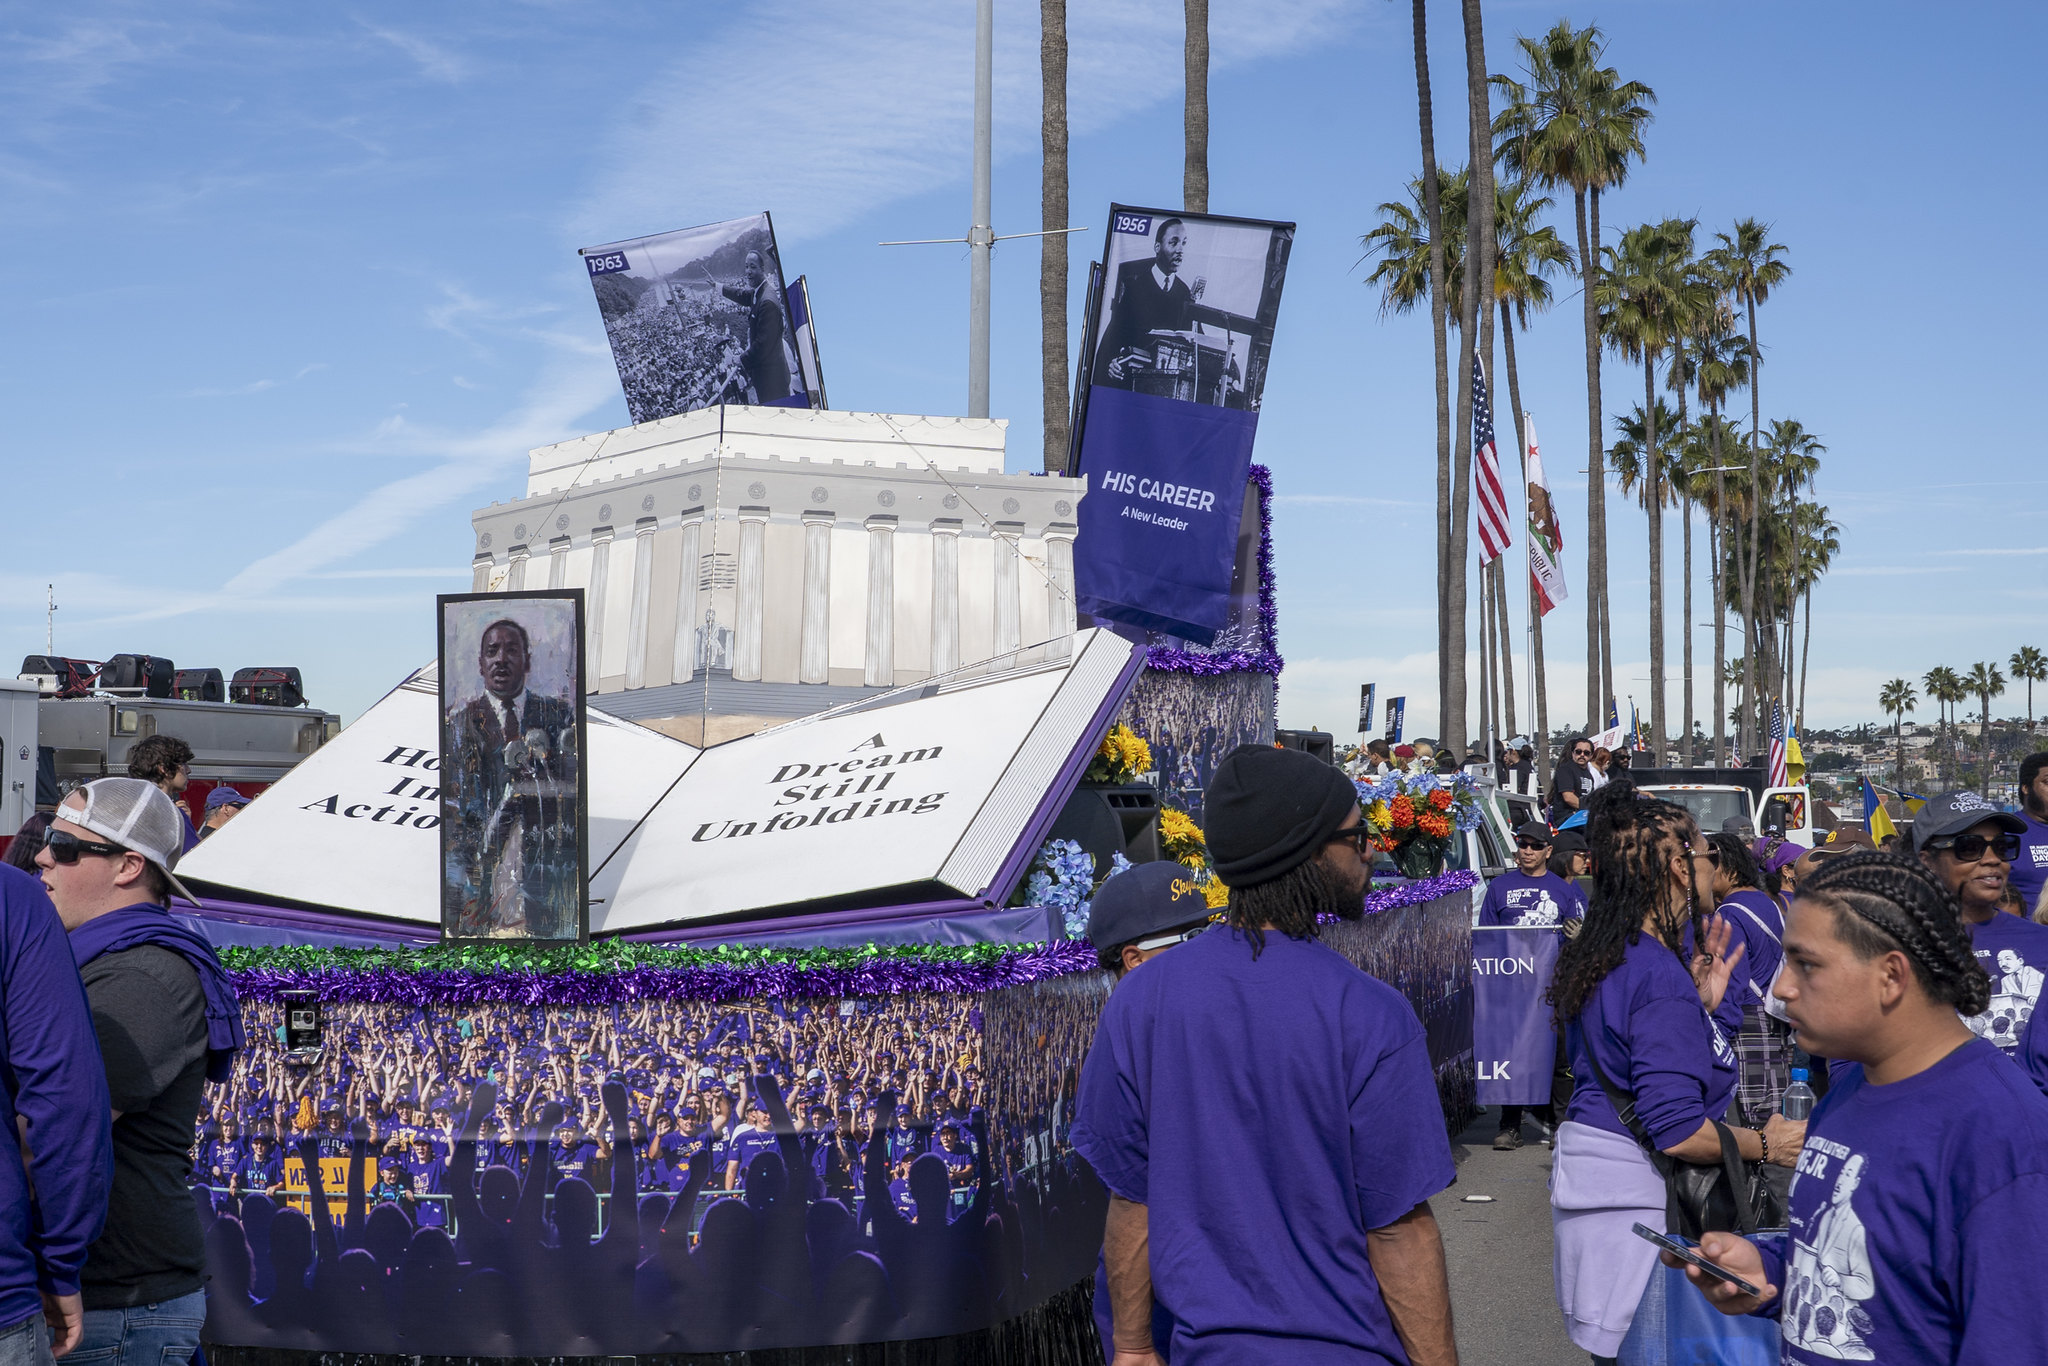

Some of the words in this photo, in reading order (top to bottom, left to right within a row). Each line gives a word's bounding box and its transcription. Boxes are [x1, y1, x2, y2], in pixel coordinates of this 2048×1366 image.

[1116, 215, 1148, 233] 1956
[588, 254, 623, 273] 1963
[1101, 470, 1137, 495] HIS
[1138, 477, 1216, 513] CAREER
[1120, 505, 1130, 518] A
[1130, 507, 1152, 523] New
[1151, 512, 1189, 532] Leader
[848, 732, 888, 753] A
[766, 745, 944, 785] Dream
[773, 771, 897, 807] Still
[691, 791, 951, 843] Unfolding
